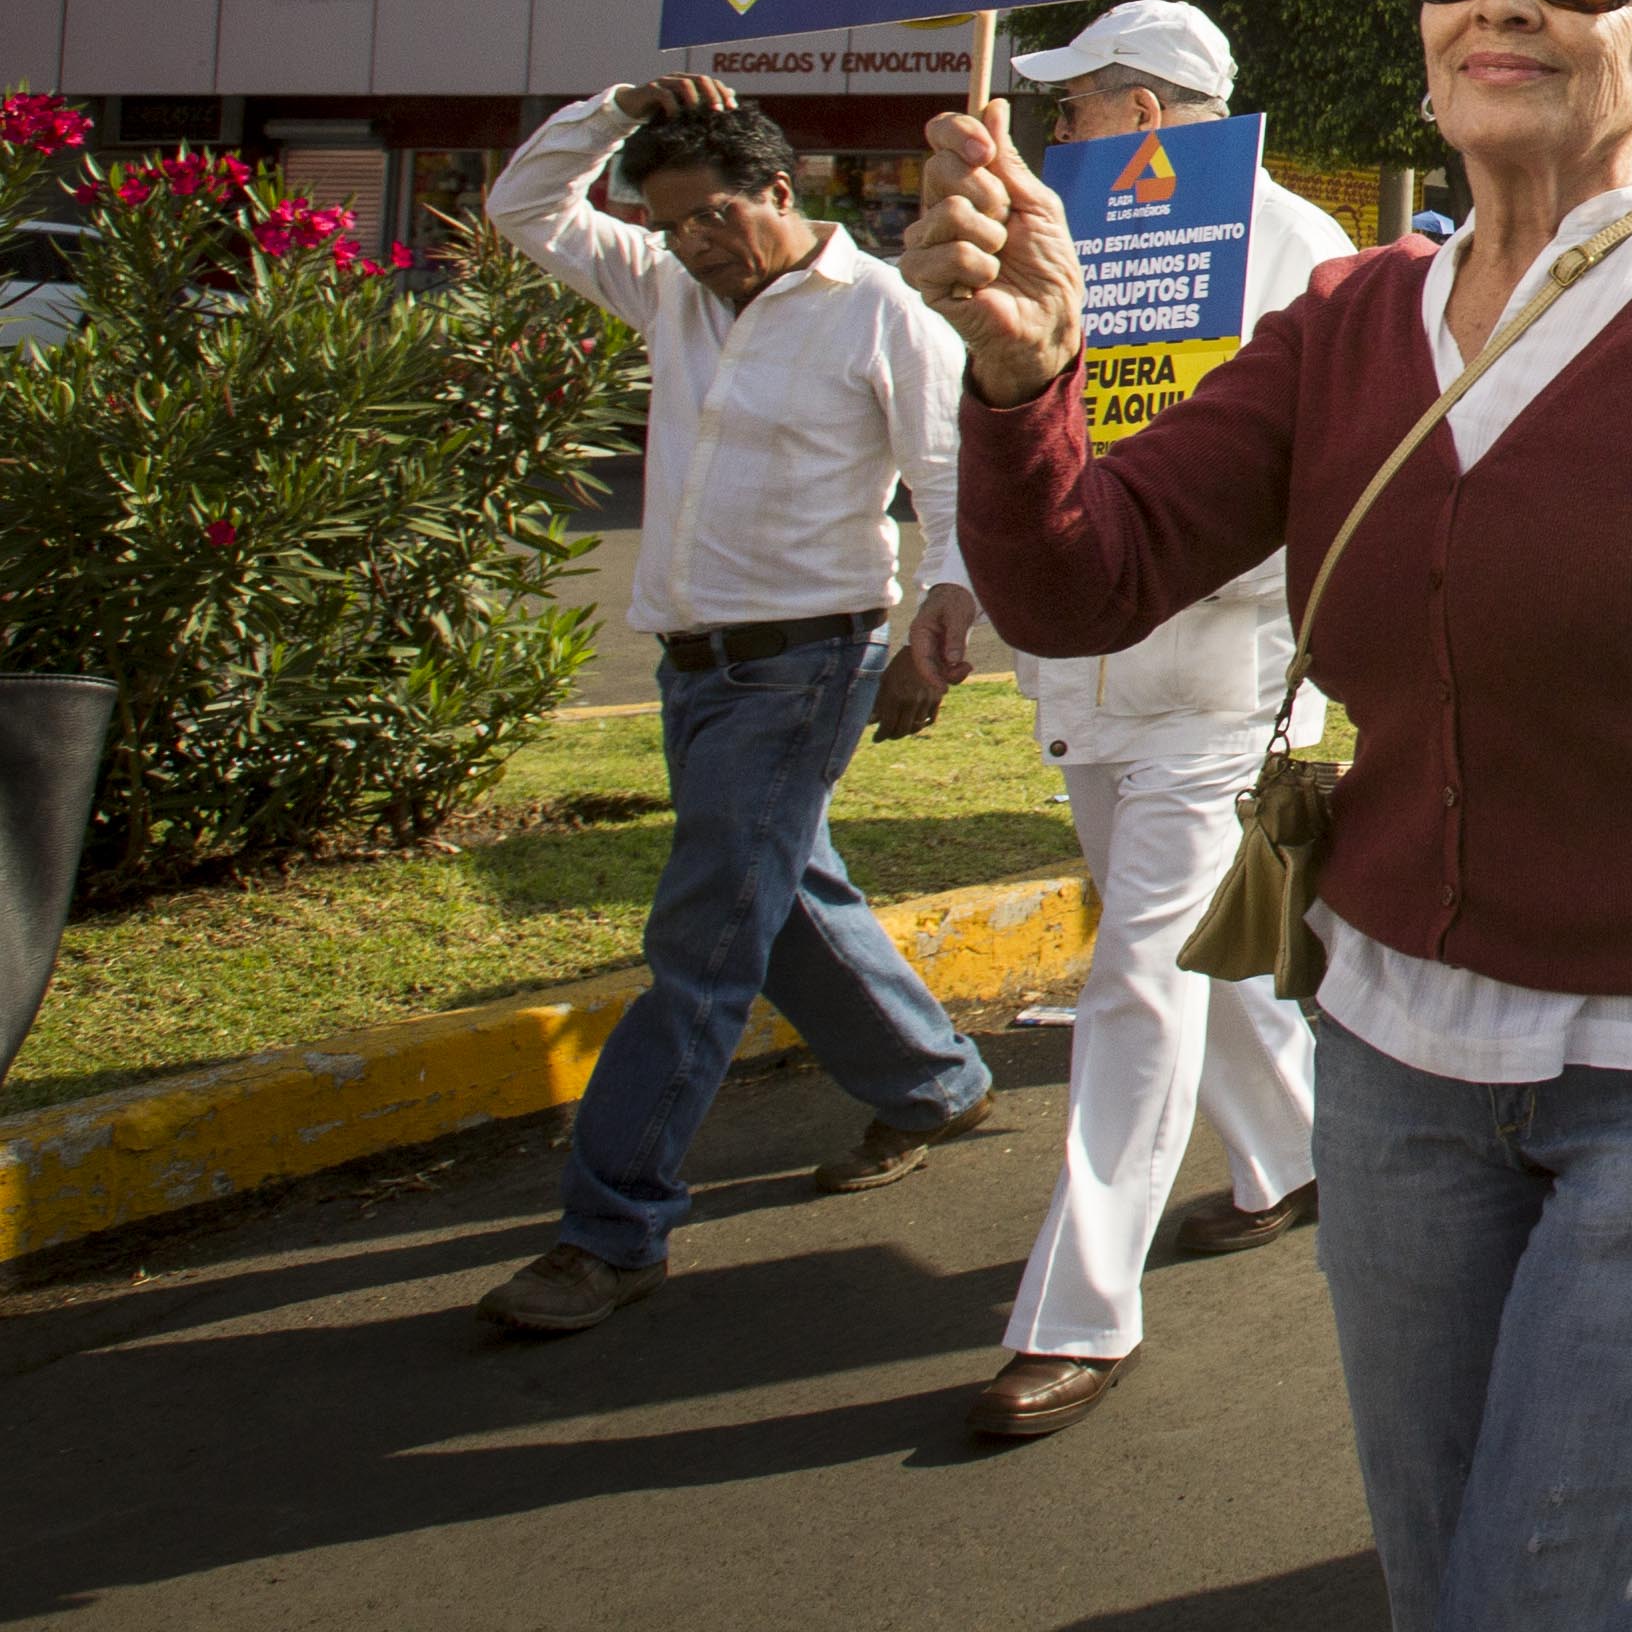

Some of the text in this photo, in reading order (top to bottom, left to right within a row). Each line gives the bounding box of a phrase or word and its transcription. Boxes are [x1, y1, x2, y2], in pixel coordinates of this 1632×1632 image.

[713, 52, 972, 73] REGALOS Y ENVOLTURA
[1105, 222, 1245, 252] ESTACIONAMIENTO
[1100, 252, 1211, 279] EN MANOS DE
[1194, 274, 1210, 298] E
